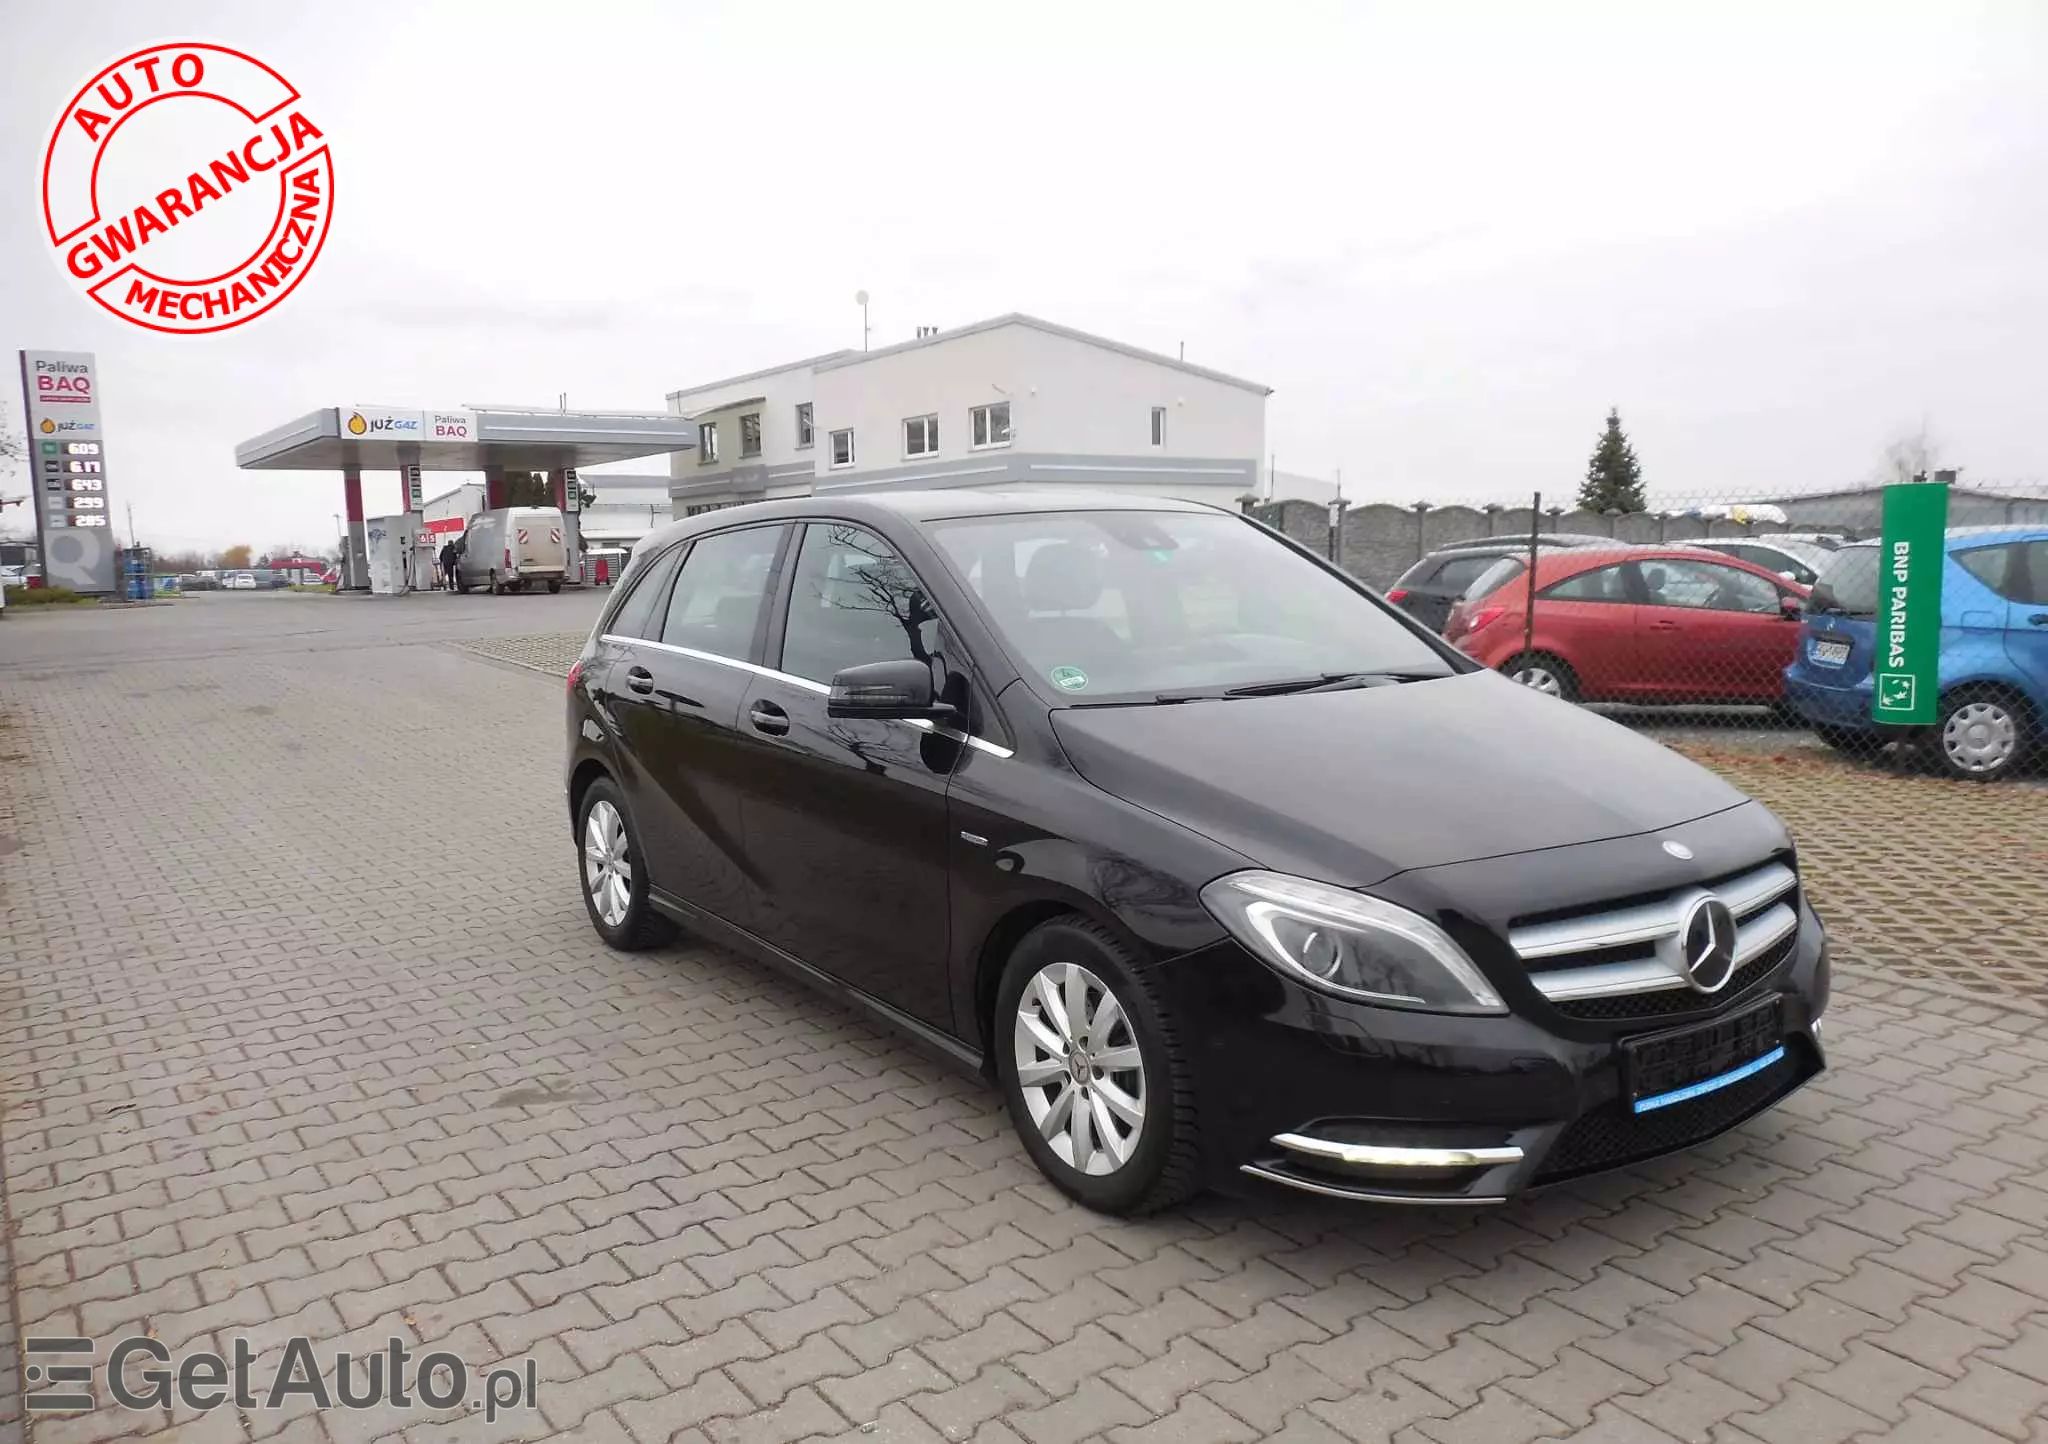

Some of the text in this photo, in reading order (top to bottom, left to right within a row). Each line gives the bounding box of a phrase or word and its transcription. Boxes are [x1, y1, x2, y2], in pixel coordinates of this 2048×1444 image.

[35, 360, 89, 374] Paliwa
[37, 375, 91, 395] BAQ
[434, 415, 467, 424] Paliwa
[435, 425, 468, 437] BAQ
[1888, 541, 1910, 668] BNP PARIBAS
